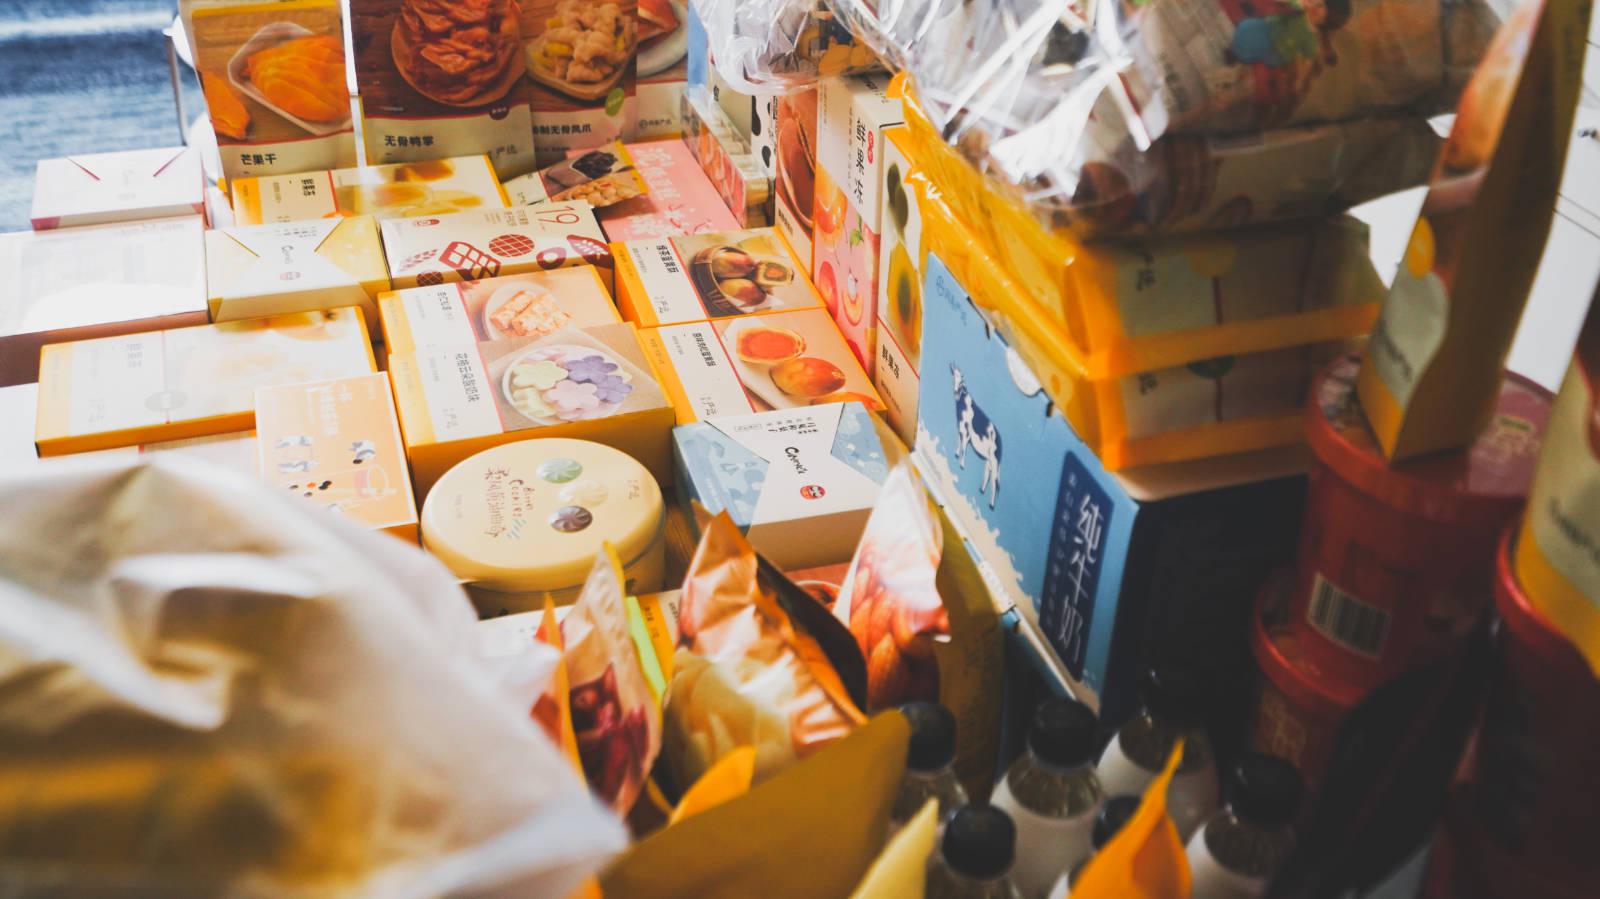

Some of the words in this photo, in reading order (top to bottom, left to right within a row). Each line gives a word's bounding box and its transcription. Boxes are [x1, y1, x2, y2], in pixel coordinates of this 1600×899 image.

[384, 135, 435, 148] 无骨鸭掌
[240, 152, 277, 166] 芒果干
[535, 206, 580, 225] 19
[1059, 493, 1105, 665] 纯牛奶
